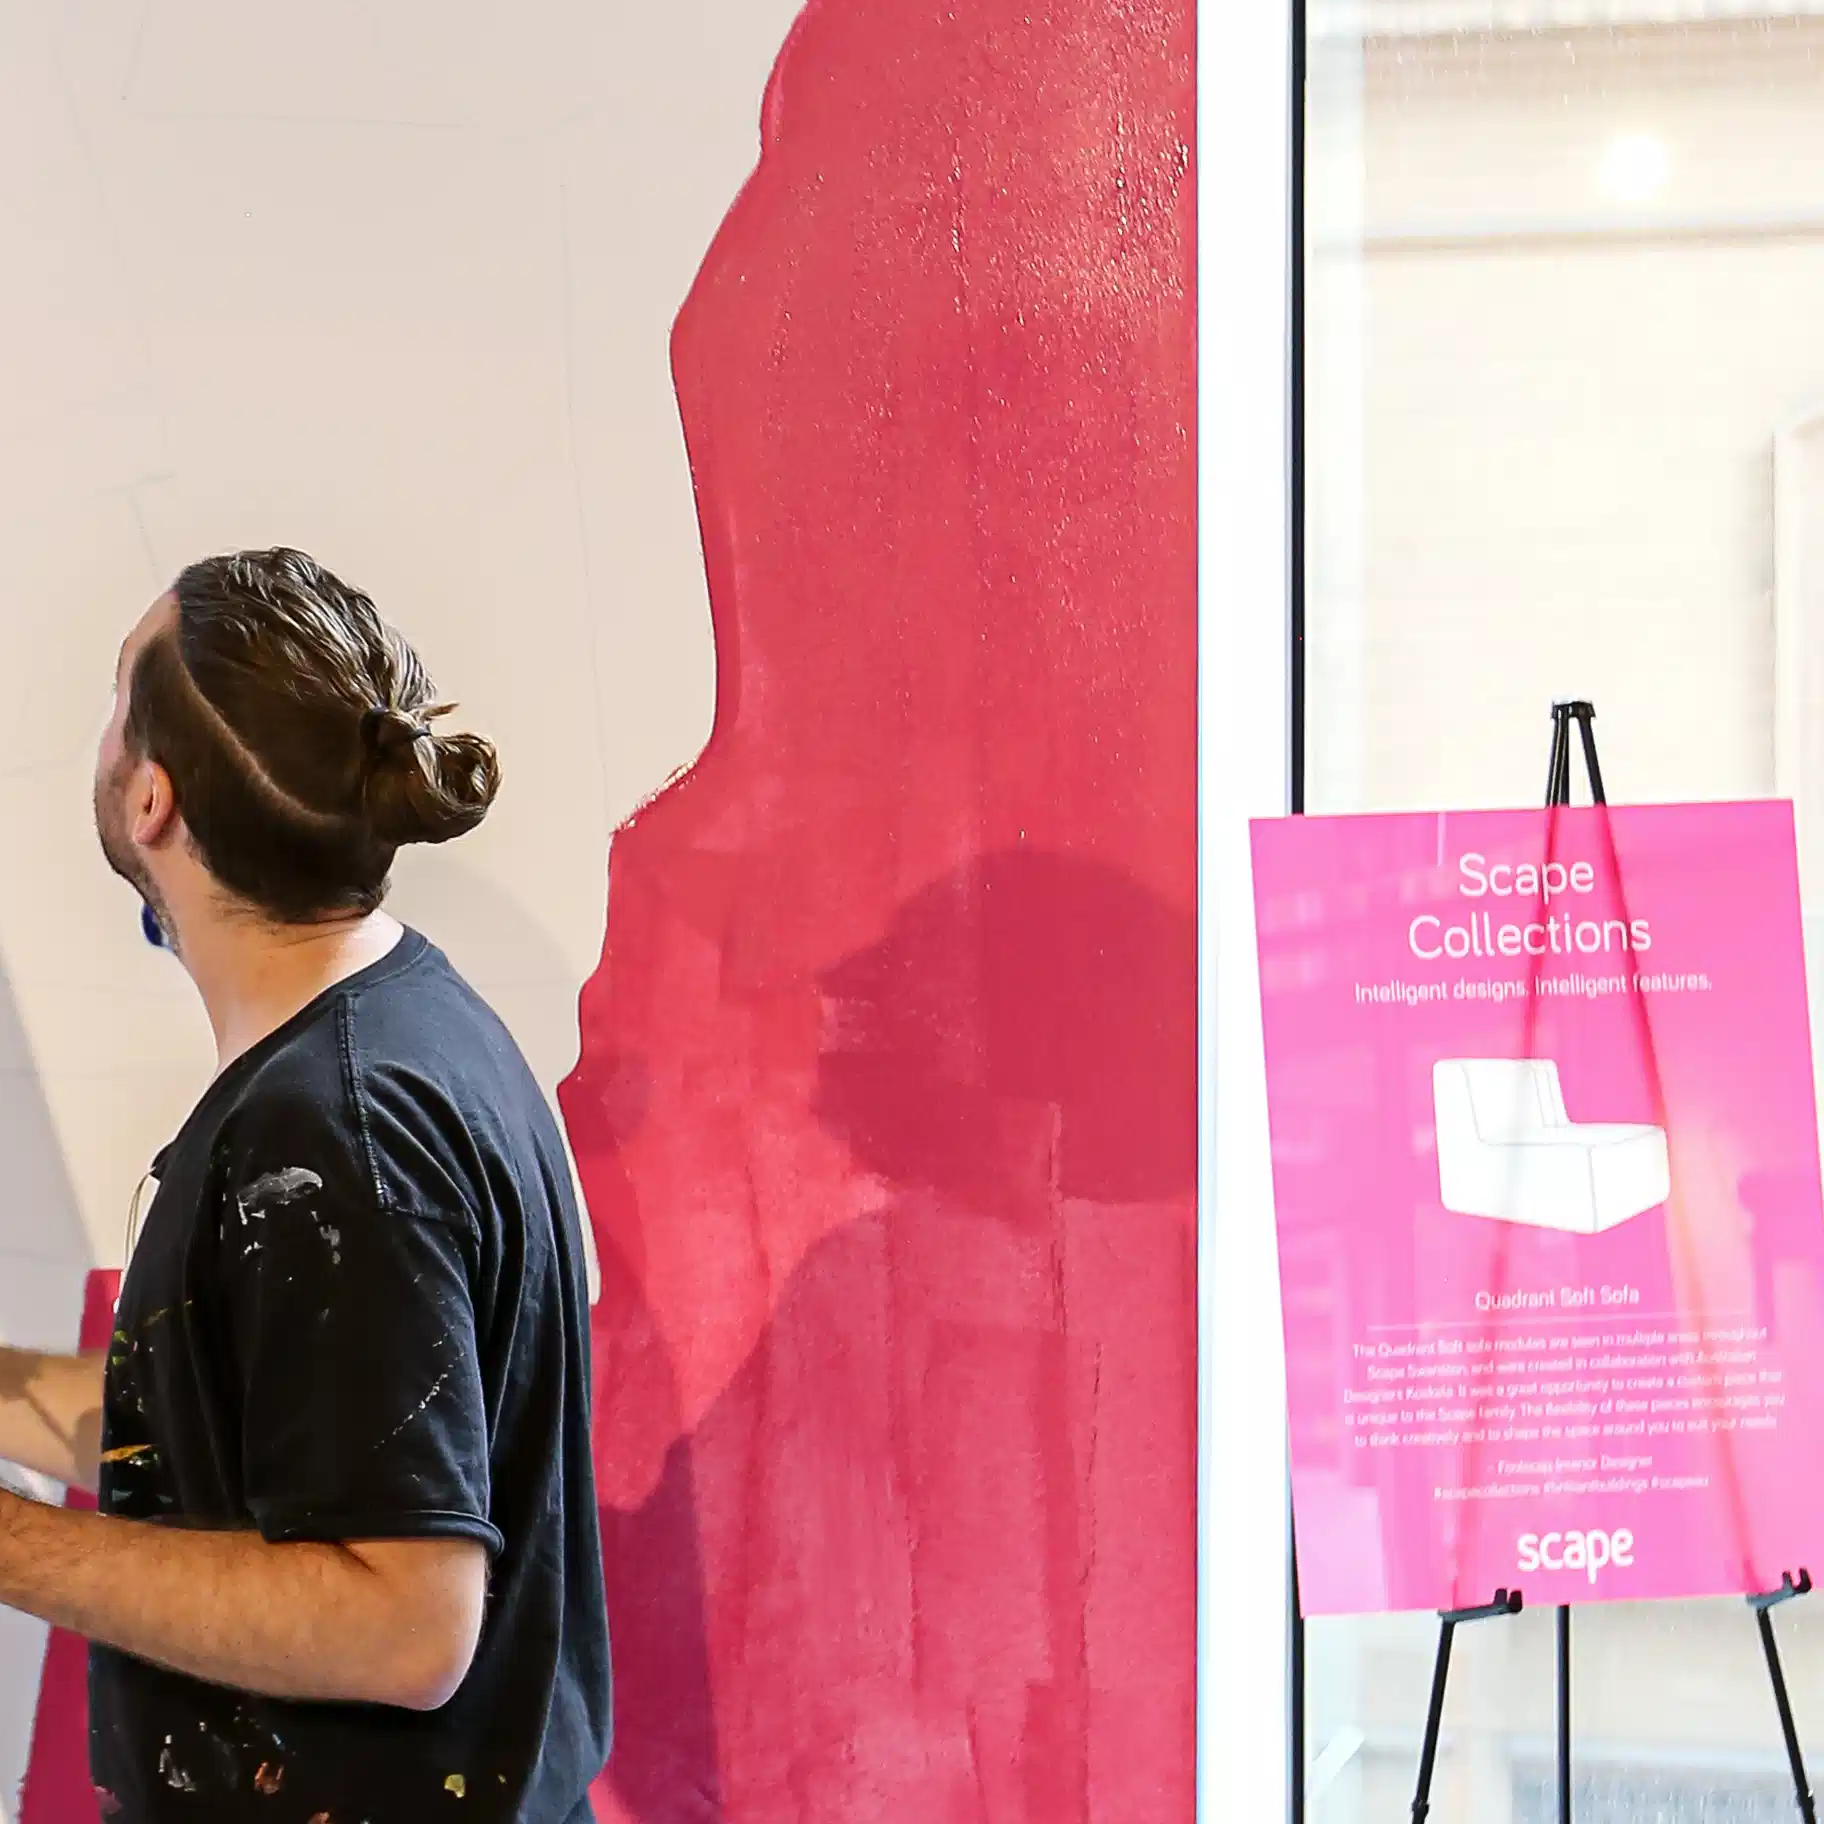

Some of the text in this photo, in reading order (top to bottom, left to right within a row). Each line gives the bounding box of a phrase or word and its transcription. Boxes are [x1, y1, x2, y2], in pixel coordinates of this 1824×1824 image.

[1458, 852, 1595, 905] Scape
[1408, 911, 1653, 961] Collections
[1354, 972, 1713, 1007] Intelligent designs. Intelligent features.
[1474, 1283, 1641, 1312] Quadrant Soft Sofa
[1516, 1527, 1635, 1585] scape
